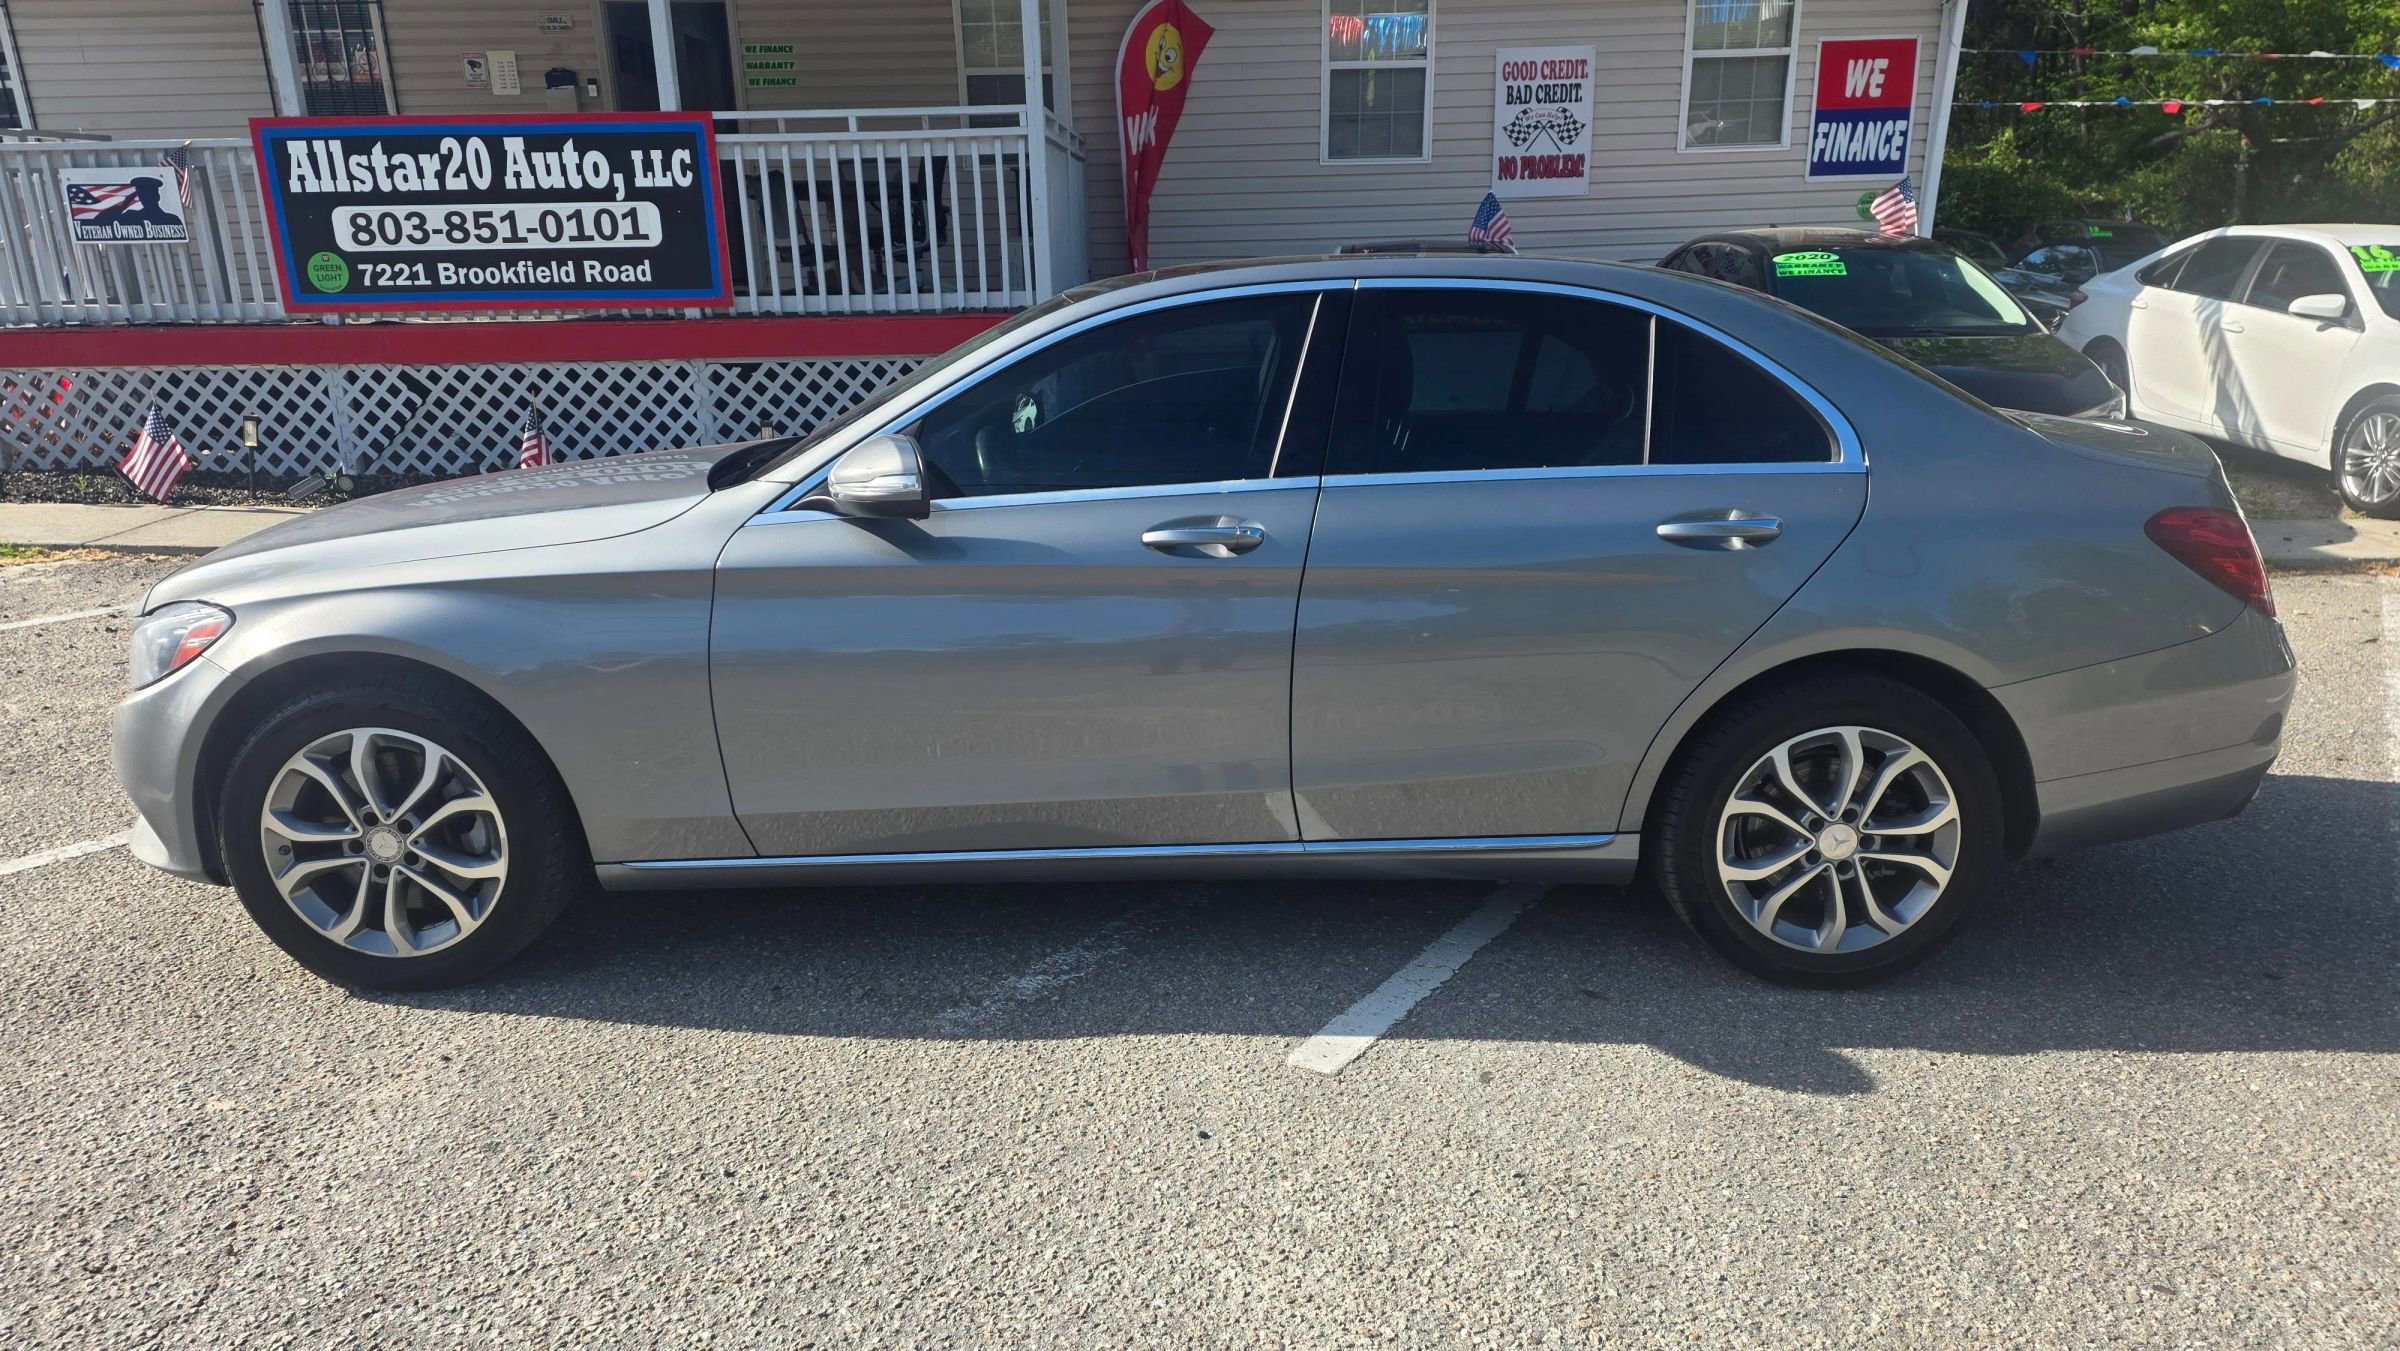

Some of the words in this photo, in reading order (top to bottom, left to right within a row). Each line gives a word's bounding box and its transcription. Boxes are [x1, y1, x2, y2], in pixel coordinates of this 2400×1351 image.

[744, 45, 757, 54] WE
[759, 45, 794, 54] FINANCE
[745, 61, 795, 70] WARRANTY
[1502, 60, 1538, 82] GOOD
[1541, 59, 1589, 81] CREDIT.
[748, 78, 761, 86] WE
[762, 77, 797, 86] FINANCE
[1845, 58, 1889, 98] WE
[1506, 84, 1533, 105] BAD
[1535, 83, 1583, 104] CREDIT.
[1812, 119, 1908, 163] FINANCE
[286, 136, 492, 193] Allstar20
[503, 136, 626, 201] Auto,
[631, 148, 694, 188] LLC
[1497, 155, 1518, 181] NO
[1520, 153, 1586, 180] PROBLEM!
[73, 220, 113, 239] VETERAN
[113, 220, 144, 239] OWNED
[143, 219, 185, 239] BUSINESS
[349, 206, 650, 247] 803-851-0101
[313, 264, 342, 273] GREEN
[1783, 253, 1832, 262] 2020
[316, 273, 342, 282] LIGHT
[357, 262, 432, 287] 7221
[437, 260, 576, 286] Brookfield
[583, 259, 653, 284] Road
